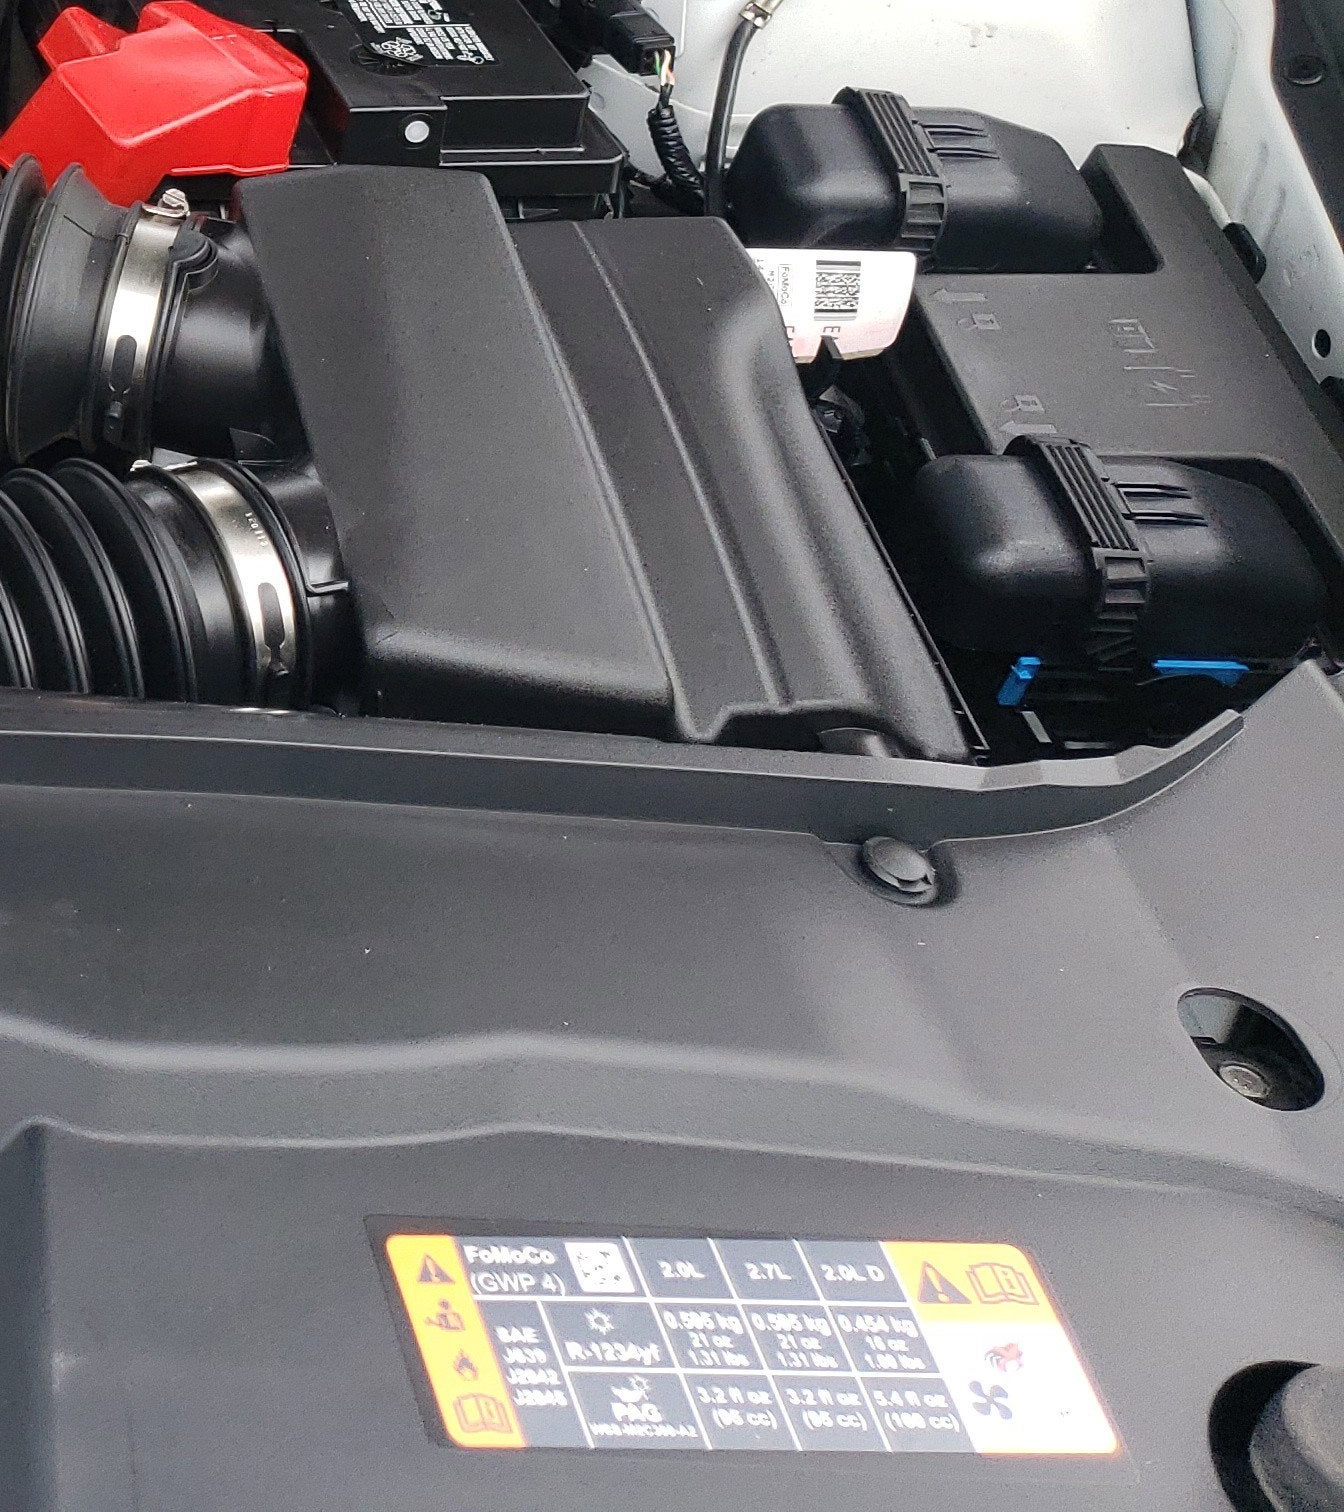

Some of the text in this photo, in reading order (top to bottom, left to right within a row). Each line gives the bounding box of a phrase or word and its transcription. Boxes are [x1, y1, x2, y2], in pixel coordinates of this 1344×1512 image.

[463, 1245, 557, 1264] FoMoCo
[658, 1260, 706, 1279] 2.0L
[745, 1261, 792, 1280] 2.7L
[821, 1262, 886, 1281] 2.0L D
[471, 1271, 565, 1296] (GWP 4)
[715, 1310, 744, 1336] kg
[803, 1312, 833, 1337] kg
[891, 1314, 920, 1338] kg
[712, 1334, 734, 1349] oz
[800, 1335, 823, 1350] oz
[887, 1337, 909, 1352] oz
[746, 1409, 778, 1431] cc)
[836, 1411, 868, 1432] cc)
[928, 1412, 961, 1433] cc)
